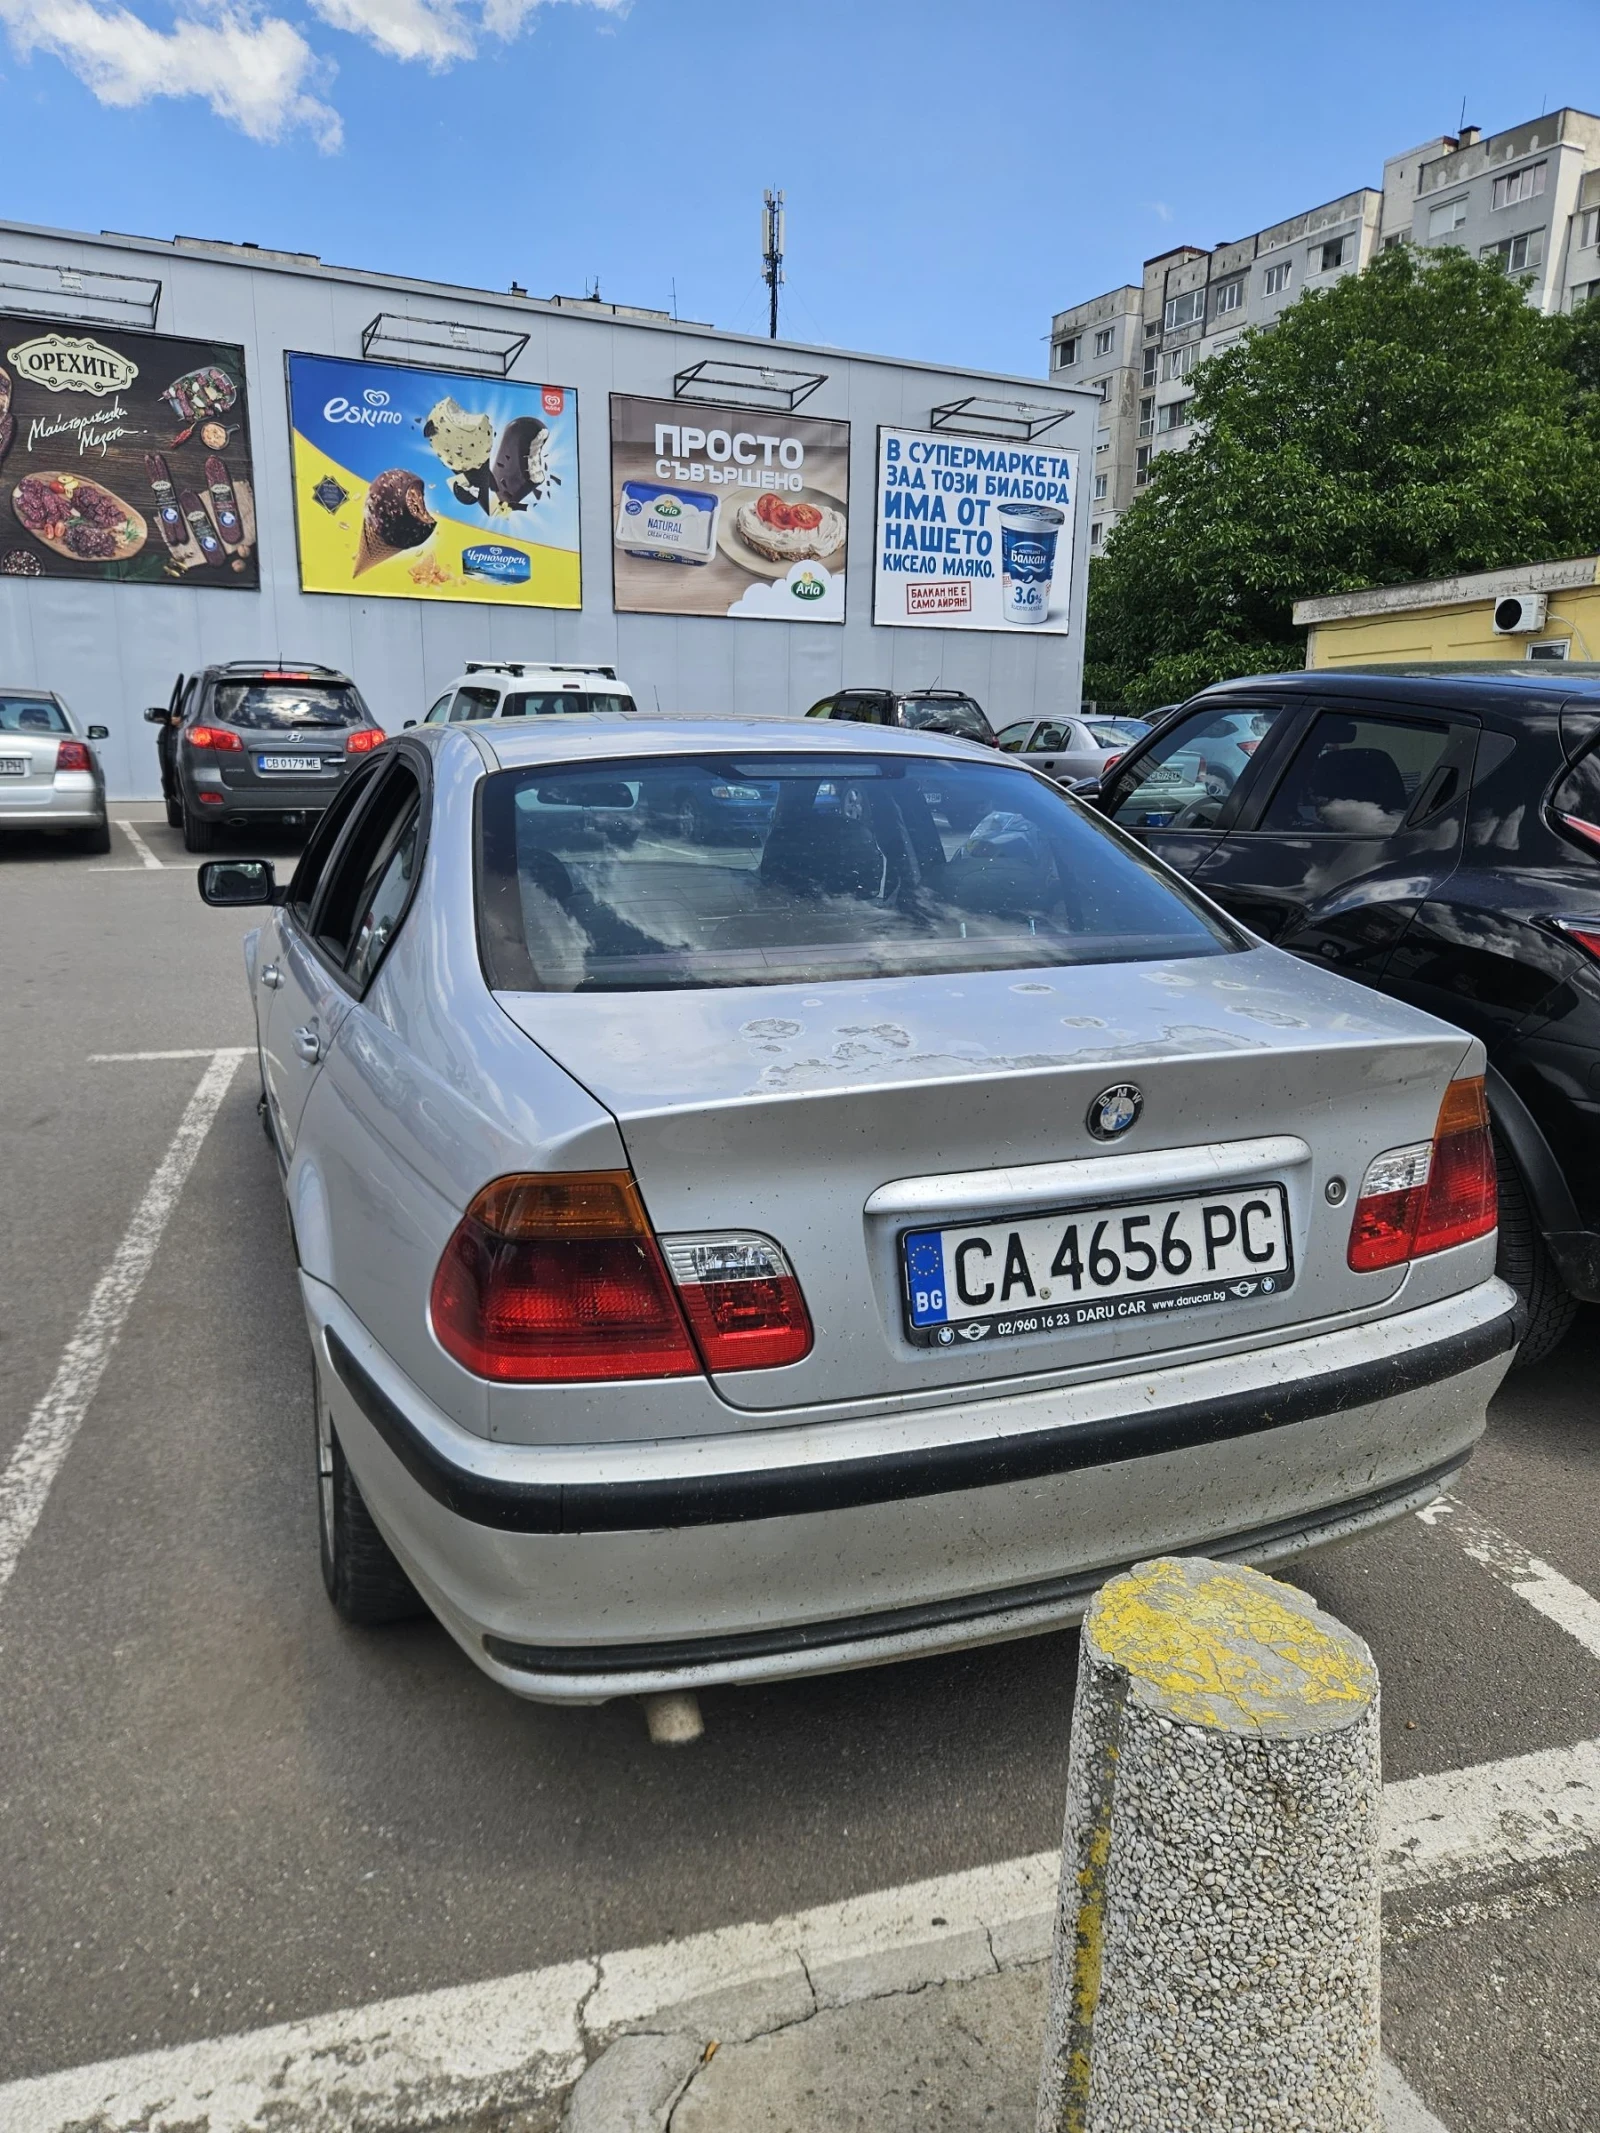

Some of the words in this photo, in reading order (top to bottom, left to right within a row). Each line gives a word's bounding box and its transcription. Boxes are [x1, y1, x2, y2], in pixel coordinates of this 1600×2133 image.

[29, 352, 120, 380] ОРЕХИТЕ
[655, 423, 804, 470] ПРОСТО
[887, 438, 900, 461] В
[909, 441, 1070, 480] СУПЕРМАРКЕТА
[655, 459, 803, 492] СЪВЪРШЕНО
[886, 464, 926, 490] ЗАД
[931, 469, 978, 494] ТОЗИ
[985, 476, 1070, 505] БИЛБОРД
[658, 506, 678, 515] Arla
[885, 490, 947, 523] ИМА
[957, 497, 991, 527] ОТ
[647, 518, 682, 534] NATURAL
[885, 522, 993, 557] НАШЕТО
[467, 549, 527, 566] Черноморец
[883, 553, 937, 574] КИСЕЛО
[943, 557, 995, 578] МЛЯКО.
[1011, 549, 1046, 565] Балкан
[795, 582, 821, 597] Arla
[911, 588, 946, 598] БАЛКАН
[948, 587, 959, 596] НЕ
[961, 587, 967, 596] Е
[911, 599, 935, 609] САМО
[266, 758, 279, 768] CB
[280, 758, 304, 768] 0179
[1098, 1087, 1142, 1107] BMW
[955, 1232, 1036, 1306] CA
[1049, 1211, 1193, 1291] 4656
[1203, 1200, 1275, 1271] PC
[915, 1289, 943, 1313] BG
[997, 1318, 1038, 1335] 02/960
[1041, 1315, 1054, 1328] 16
[1056, 1313, 1070, 1326] 23
[1076, 1305, 1115, 1323] DARU
[1118, 1300, 1146, 1317] CAR
[1152, 1290, 1226, 1311] www.darucar.bg
